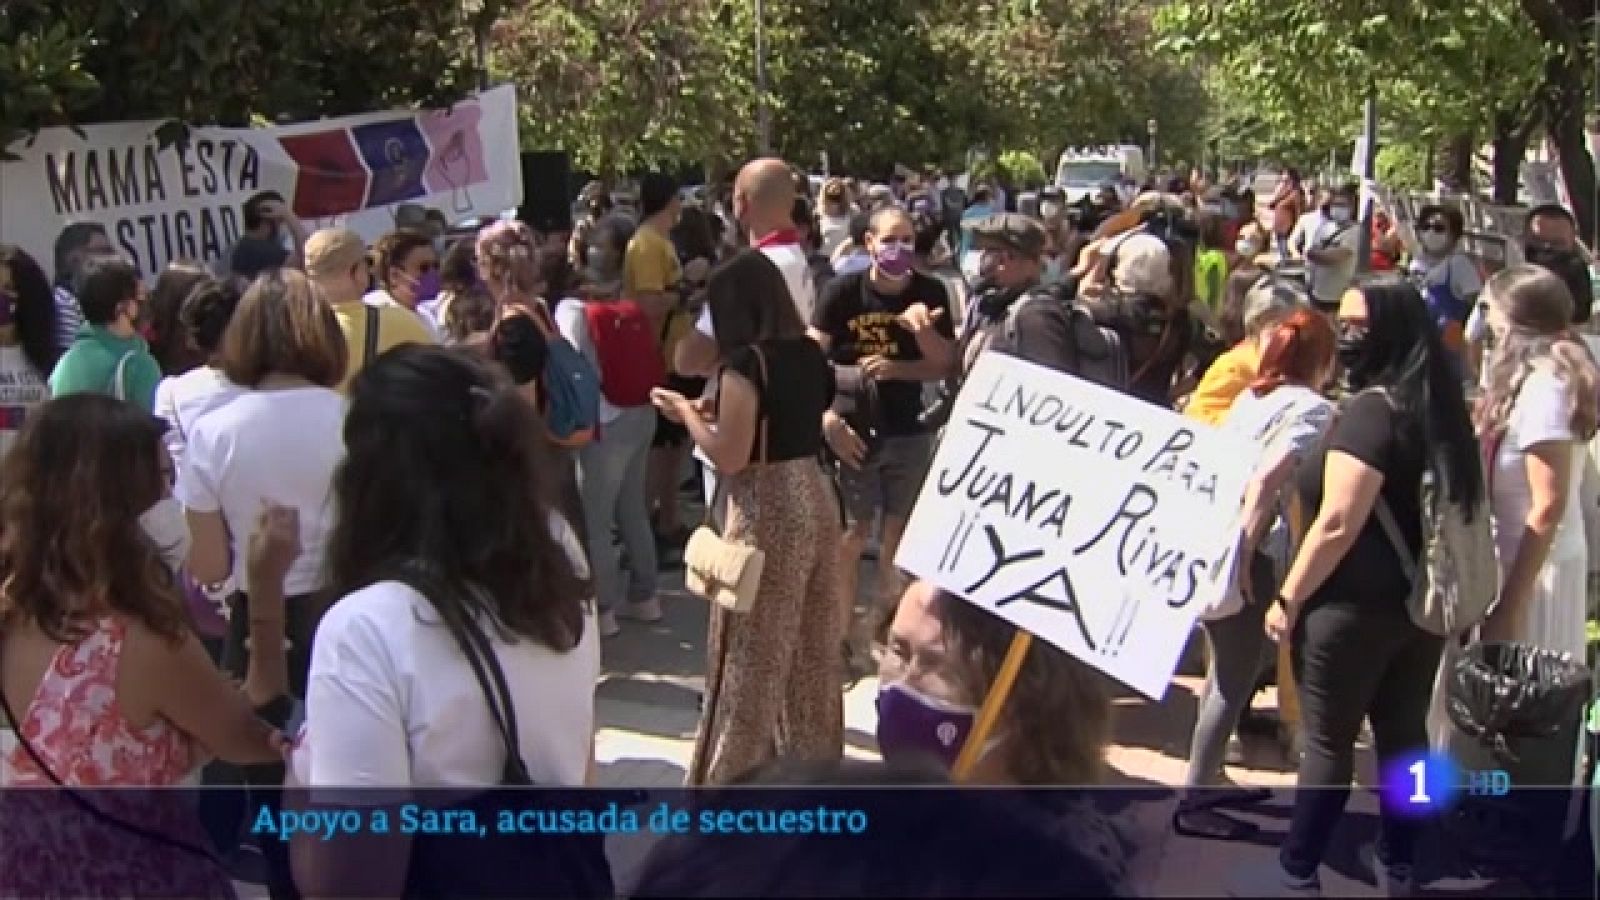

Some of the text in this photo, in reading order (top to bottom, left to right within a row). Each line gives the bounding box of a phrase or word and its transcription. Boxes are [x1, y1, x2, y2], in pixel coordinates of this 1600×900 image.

[938, 419, 1073, 538] JUANA
[974, 372, 1218, 503] INDULTO PARA
